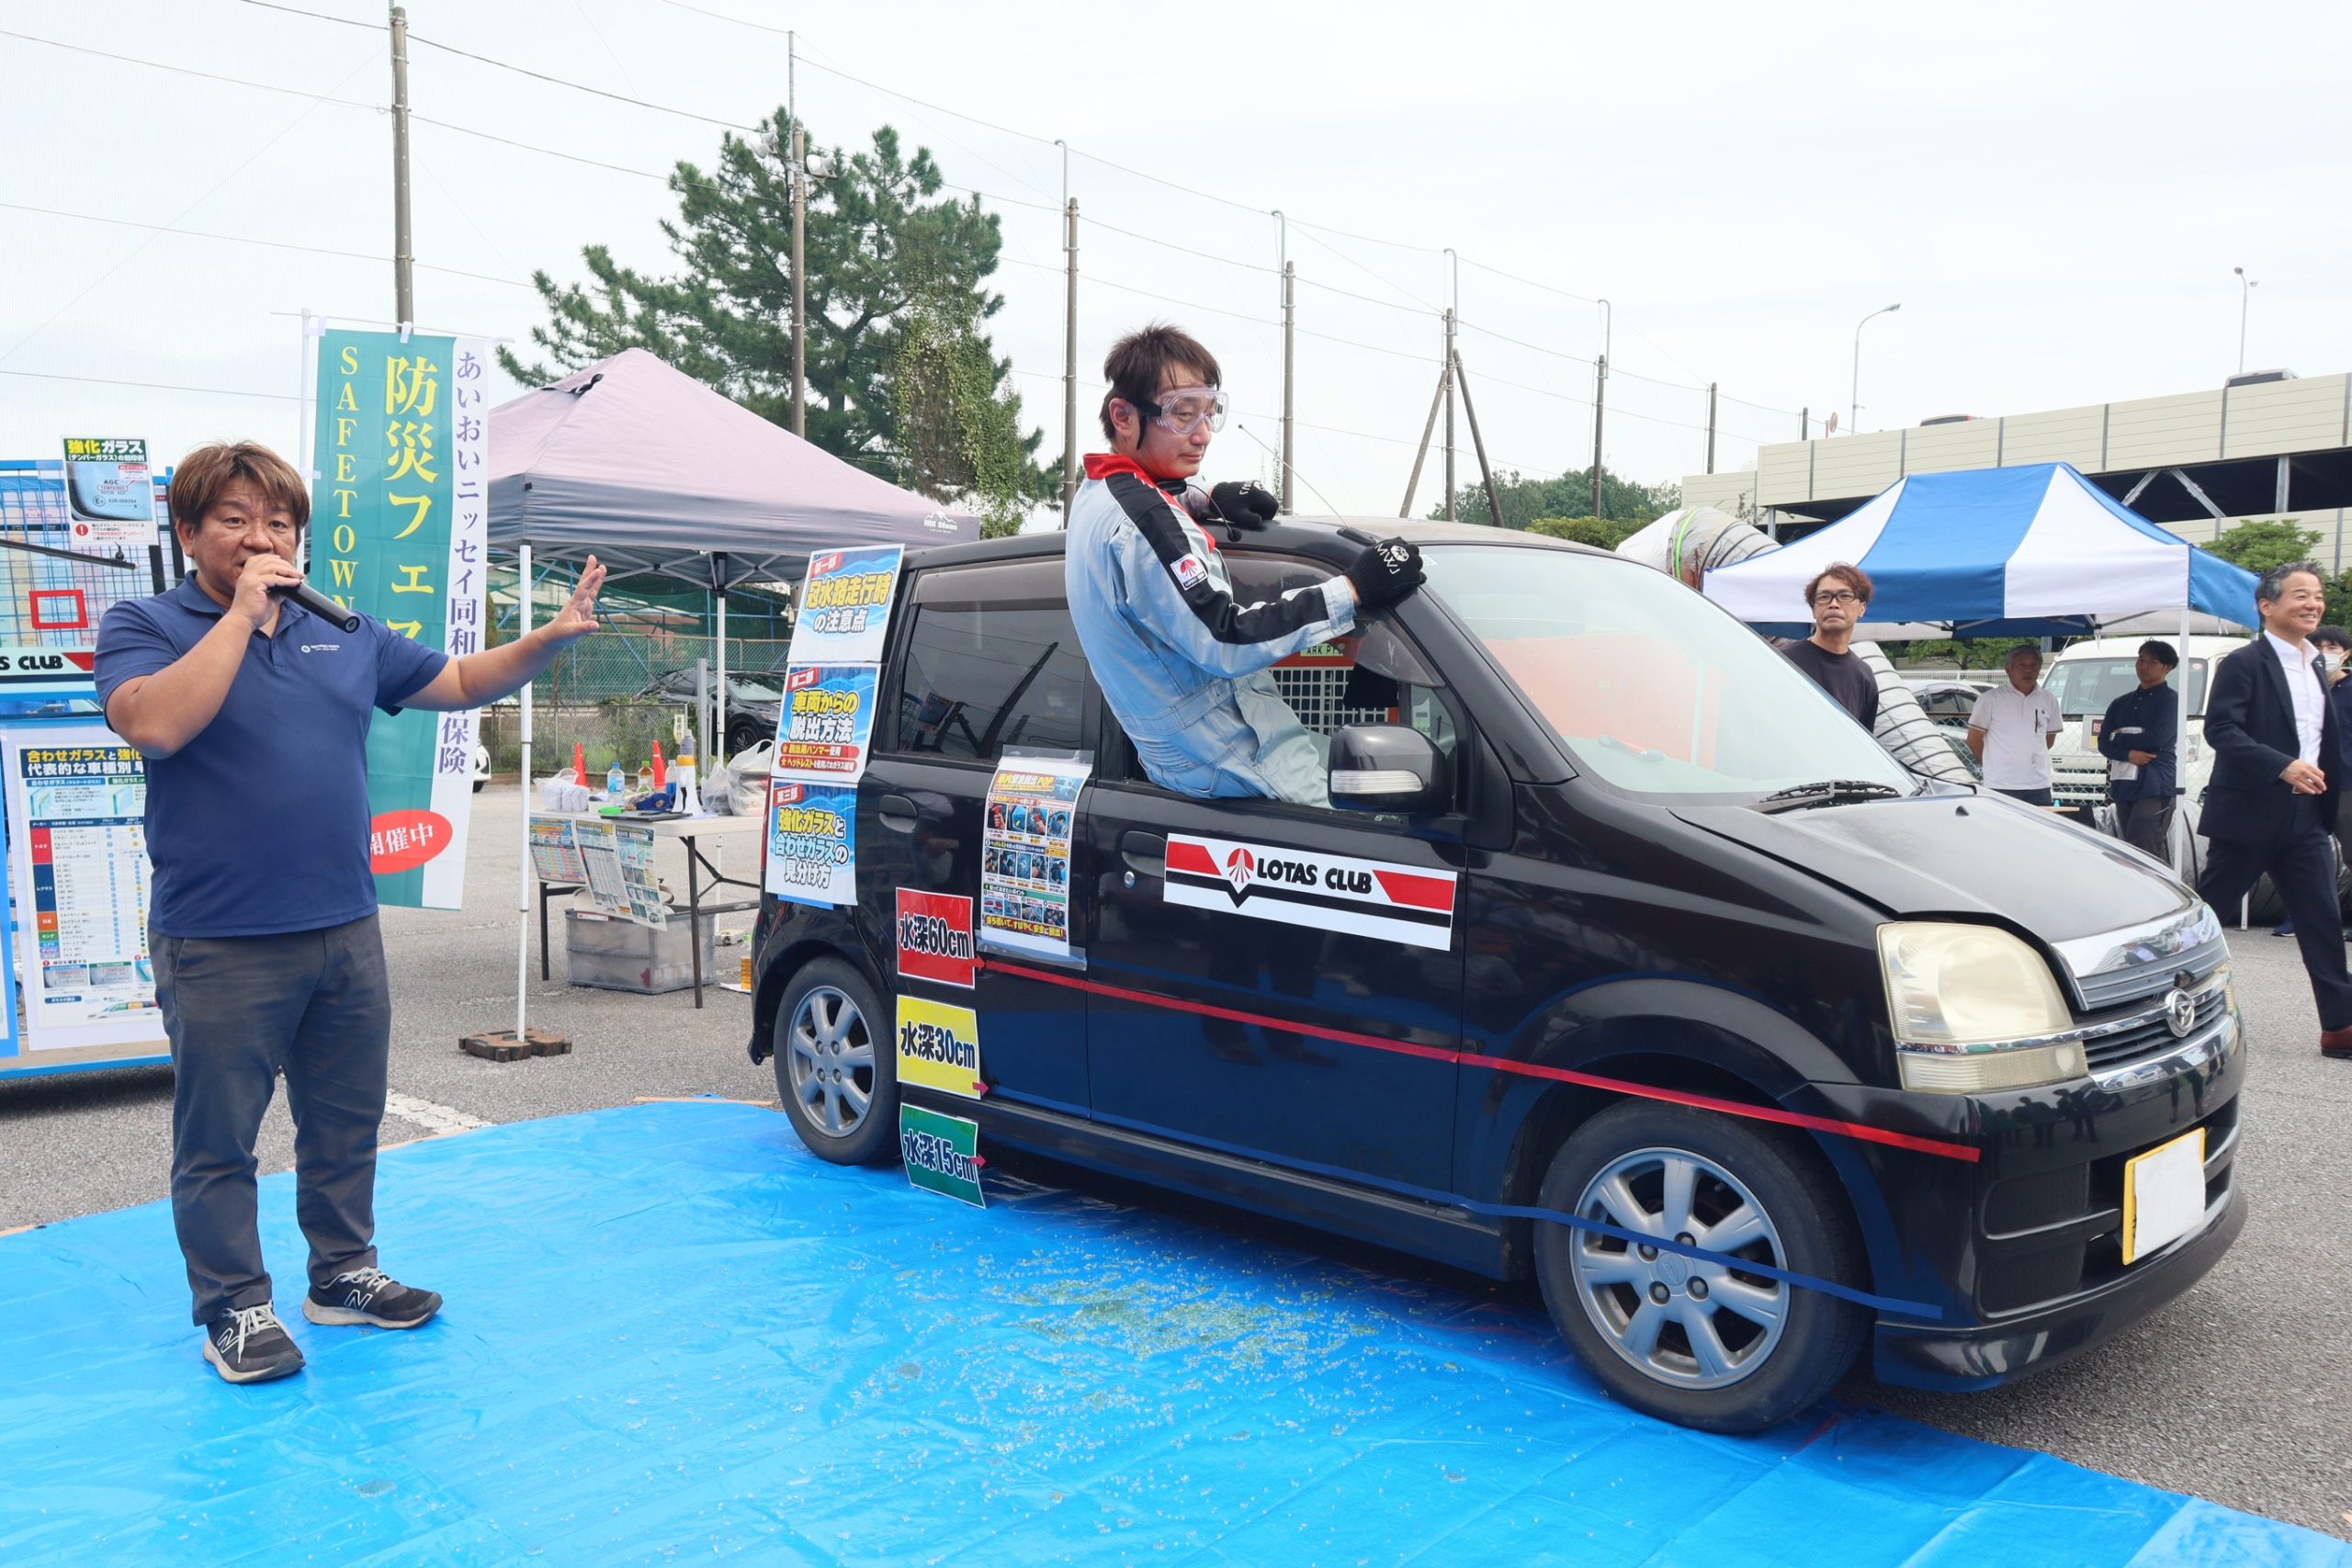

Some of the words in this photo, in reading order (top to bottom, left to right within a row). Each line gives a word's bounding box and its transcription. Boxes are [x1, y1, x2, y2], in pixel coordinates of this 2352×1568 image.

[67, 440, 143, 454] 強化ガラス
[438, 351, 481, 774] あいおいニッセイ同和保険
[806, 572, 893, 610] 冠水路走行時
[813, 608, 868, 633] の注意点
[17, 655, 63, 671] CLUB
[792, 689, 859, 716] 車両からの
[788, 716, 854, 744] 脱出方法
[779, 807, 845, 839] 強化ガラスと
[775, 833, 849, 864] 合わせガラスの
[784, 858, 831, 888] 見分け方
[1257, 858, 1317, 886] LOTAS
[1325, 867, 1372, 895] CLUB
[899, 912, 971, 960] 水深60cm
[900, 1020, 976, 1070] 水深30cm
[903, 1128, 977, 1183] 水深15cm
[344, 1289, 373, 1312] N
[217, 1327, 242, 1355] N
